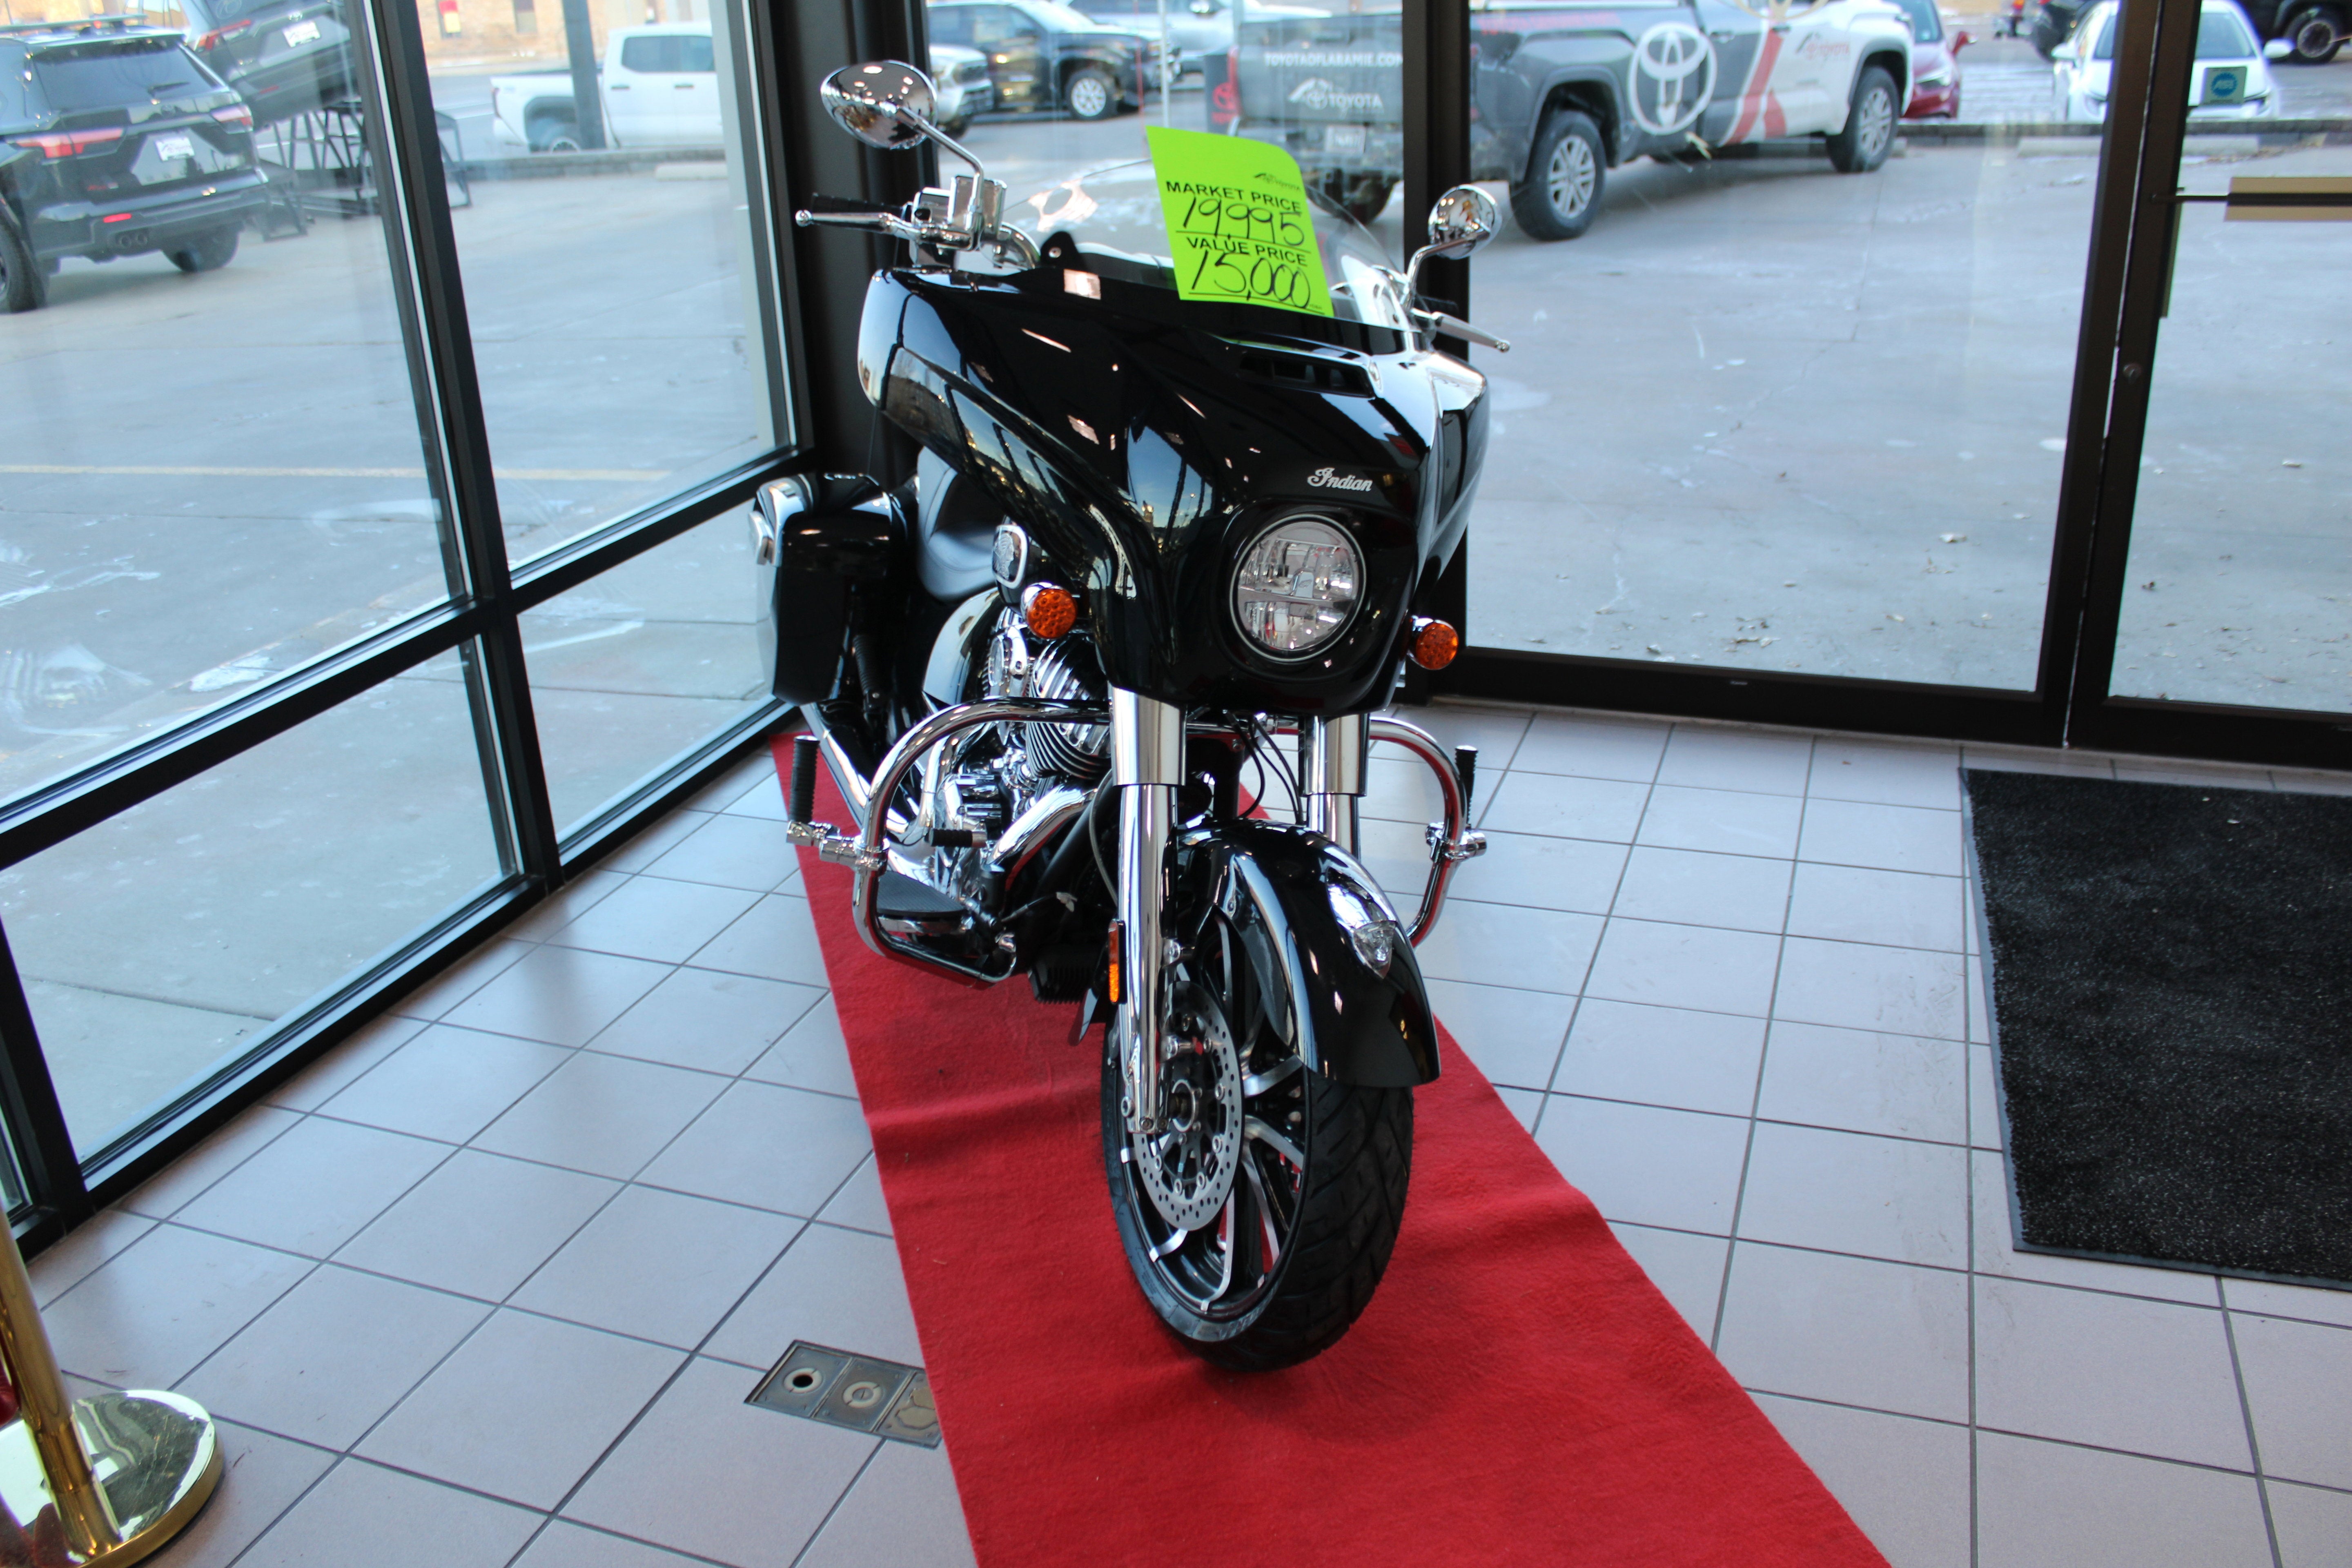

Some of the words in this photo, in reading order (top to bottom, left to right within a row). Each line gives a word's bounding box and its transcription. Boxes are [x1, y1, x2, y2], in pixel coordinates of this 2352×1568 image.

[1329, 94, 1384, 109] TOYOTA
[1166, 181, 1244, 200] MARKET
[1252, 192, 1301, 212] PRICE
[1187, 237, 1249, 254] VALUE
[1255, 245, 1307, 267] PRICE
[1307, 467, 1373, 491] Indian
